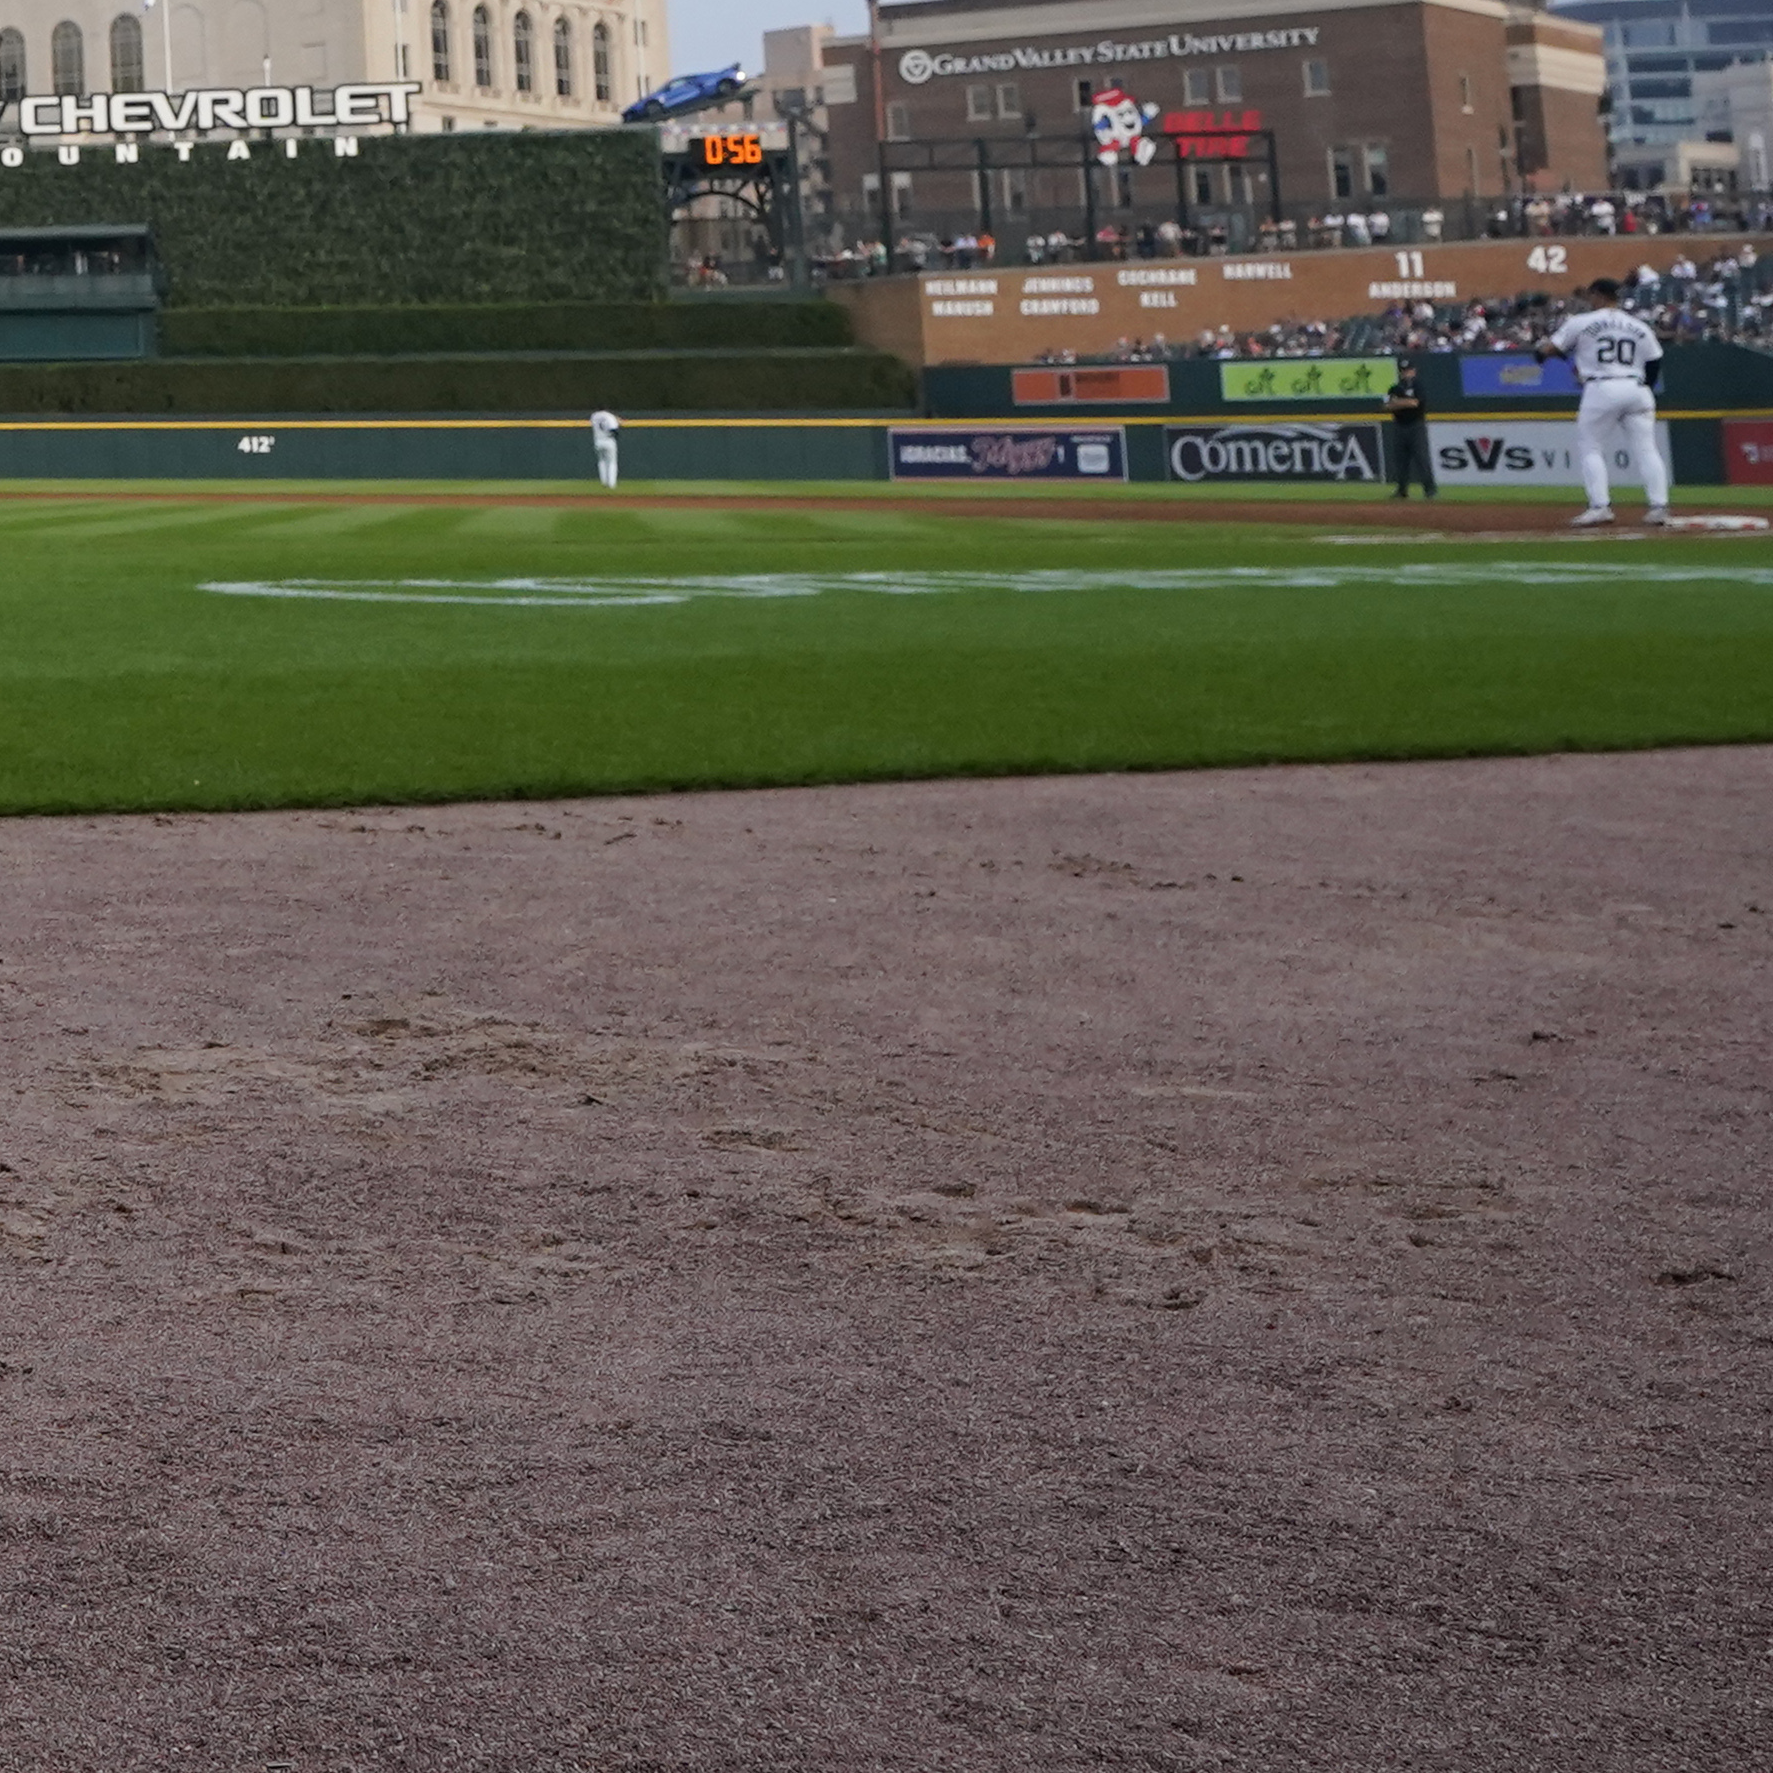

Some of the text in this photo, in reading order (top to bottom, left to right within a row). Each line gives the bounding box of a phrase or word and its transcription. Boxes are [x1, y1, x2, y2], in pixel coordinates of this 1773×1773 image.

[1168, 27, 1320, 56] UNIVERSITY
[20, 83, 420, 136] CHEVROLET
[1163, 111, 1261, 132] BELLE
[1178, 136, 1250, 157] TIRE
[1394, 251, 1423, 278] 11
[1526, 245, 1568, 273] 42
[1597, 338, 1636, 364] 20
[237, 435, 276, 454] 412'
